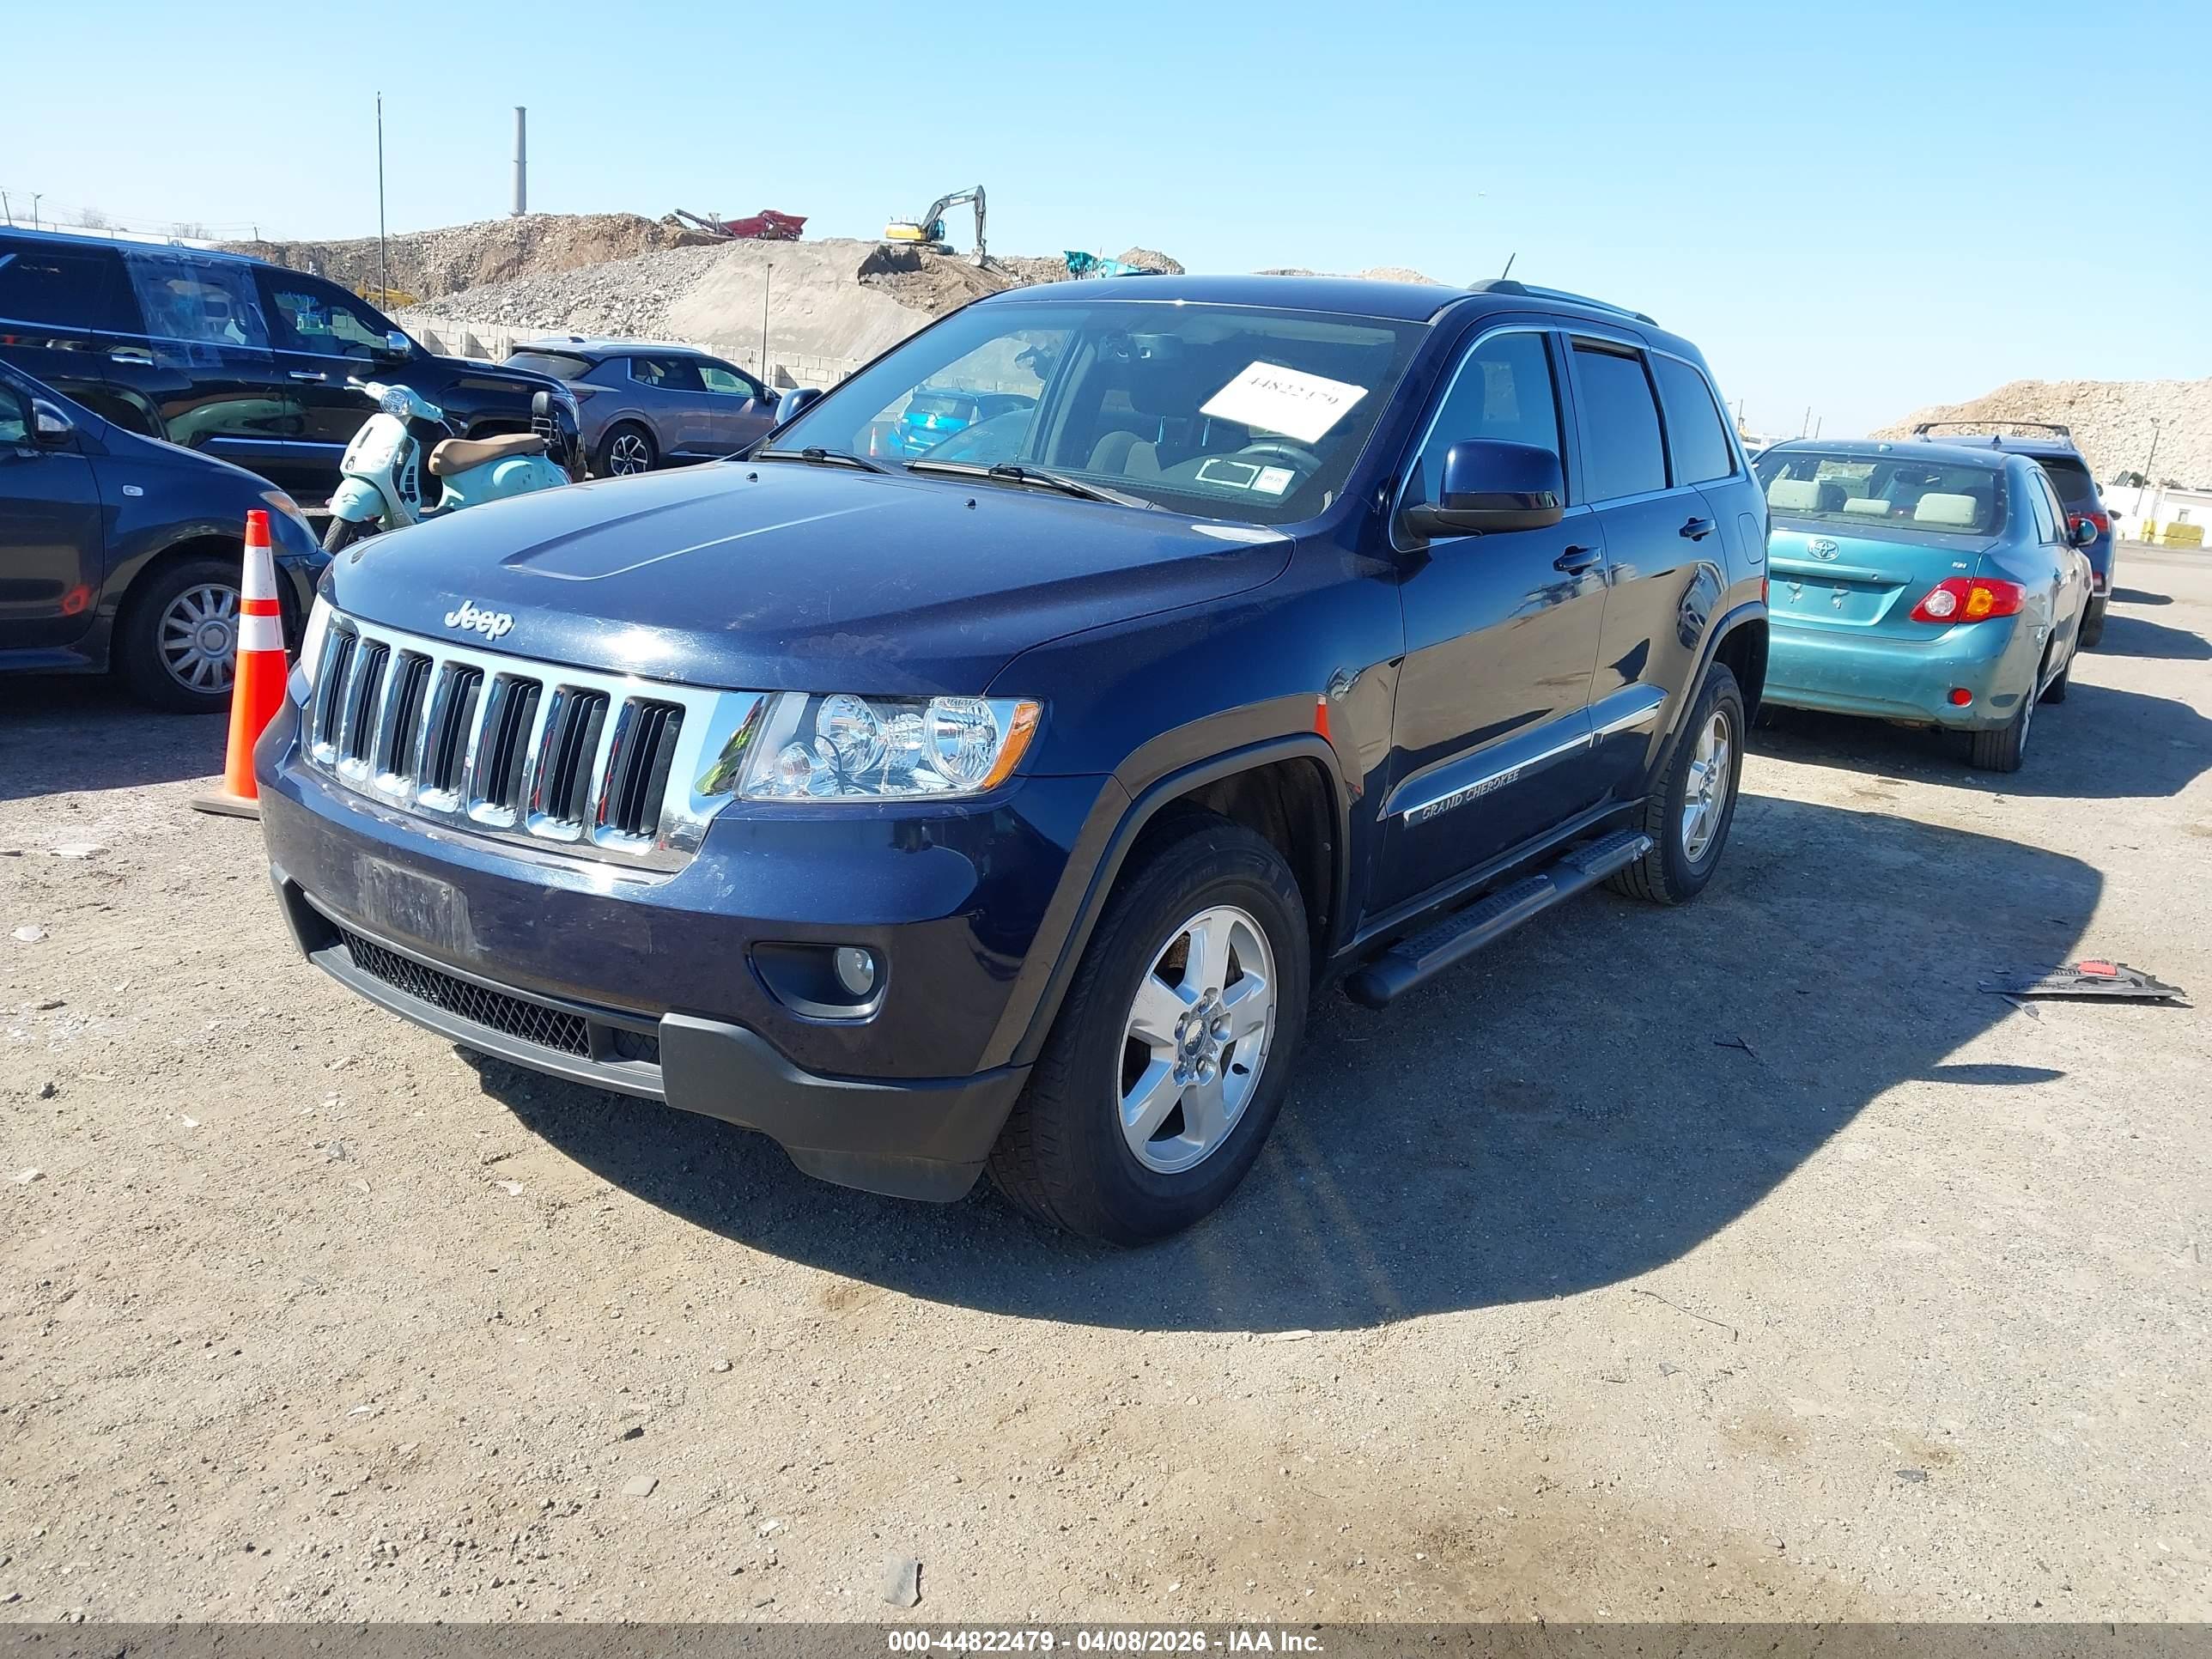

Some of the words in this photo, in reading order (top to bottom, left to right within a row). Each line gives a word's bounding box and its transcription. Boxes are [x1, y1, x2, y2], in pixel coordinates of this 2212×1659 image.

[444, 599, 514, 641] Jeep
[1421, 793, 1463, 820] GRAND
[1465, 769, 1521, 801] CHEROKEE
